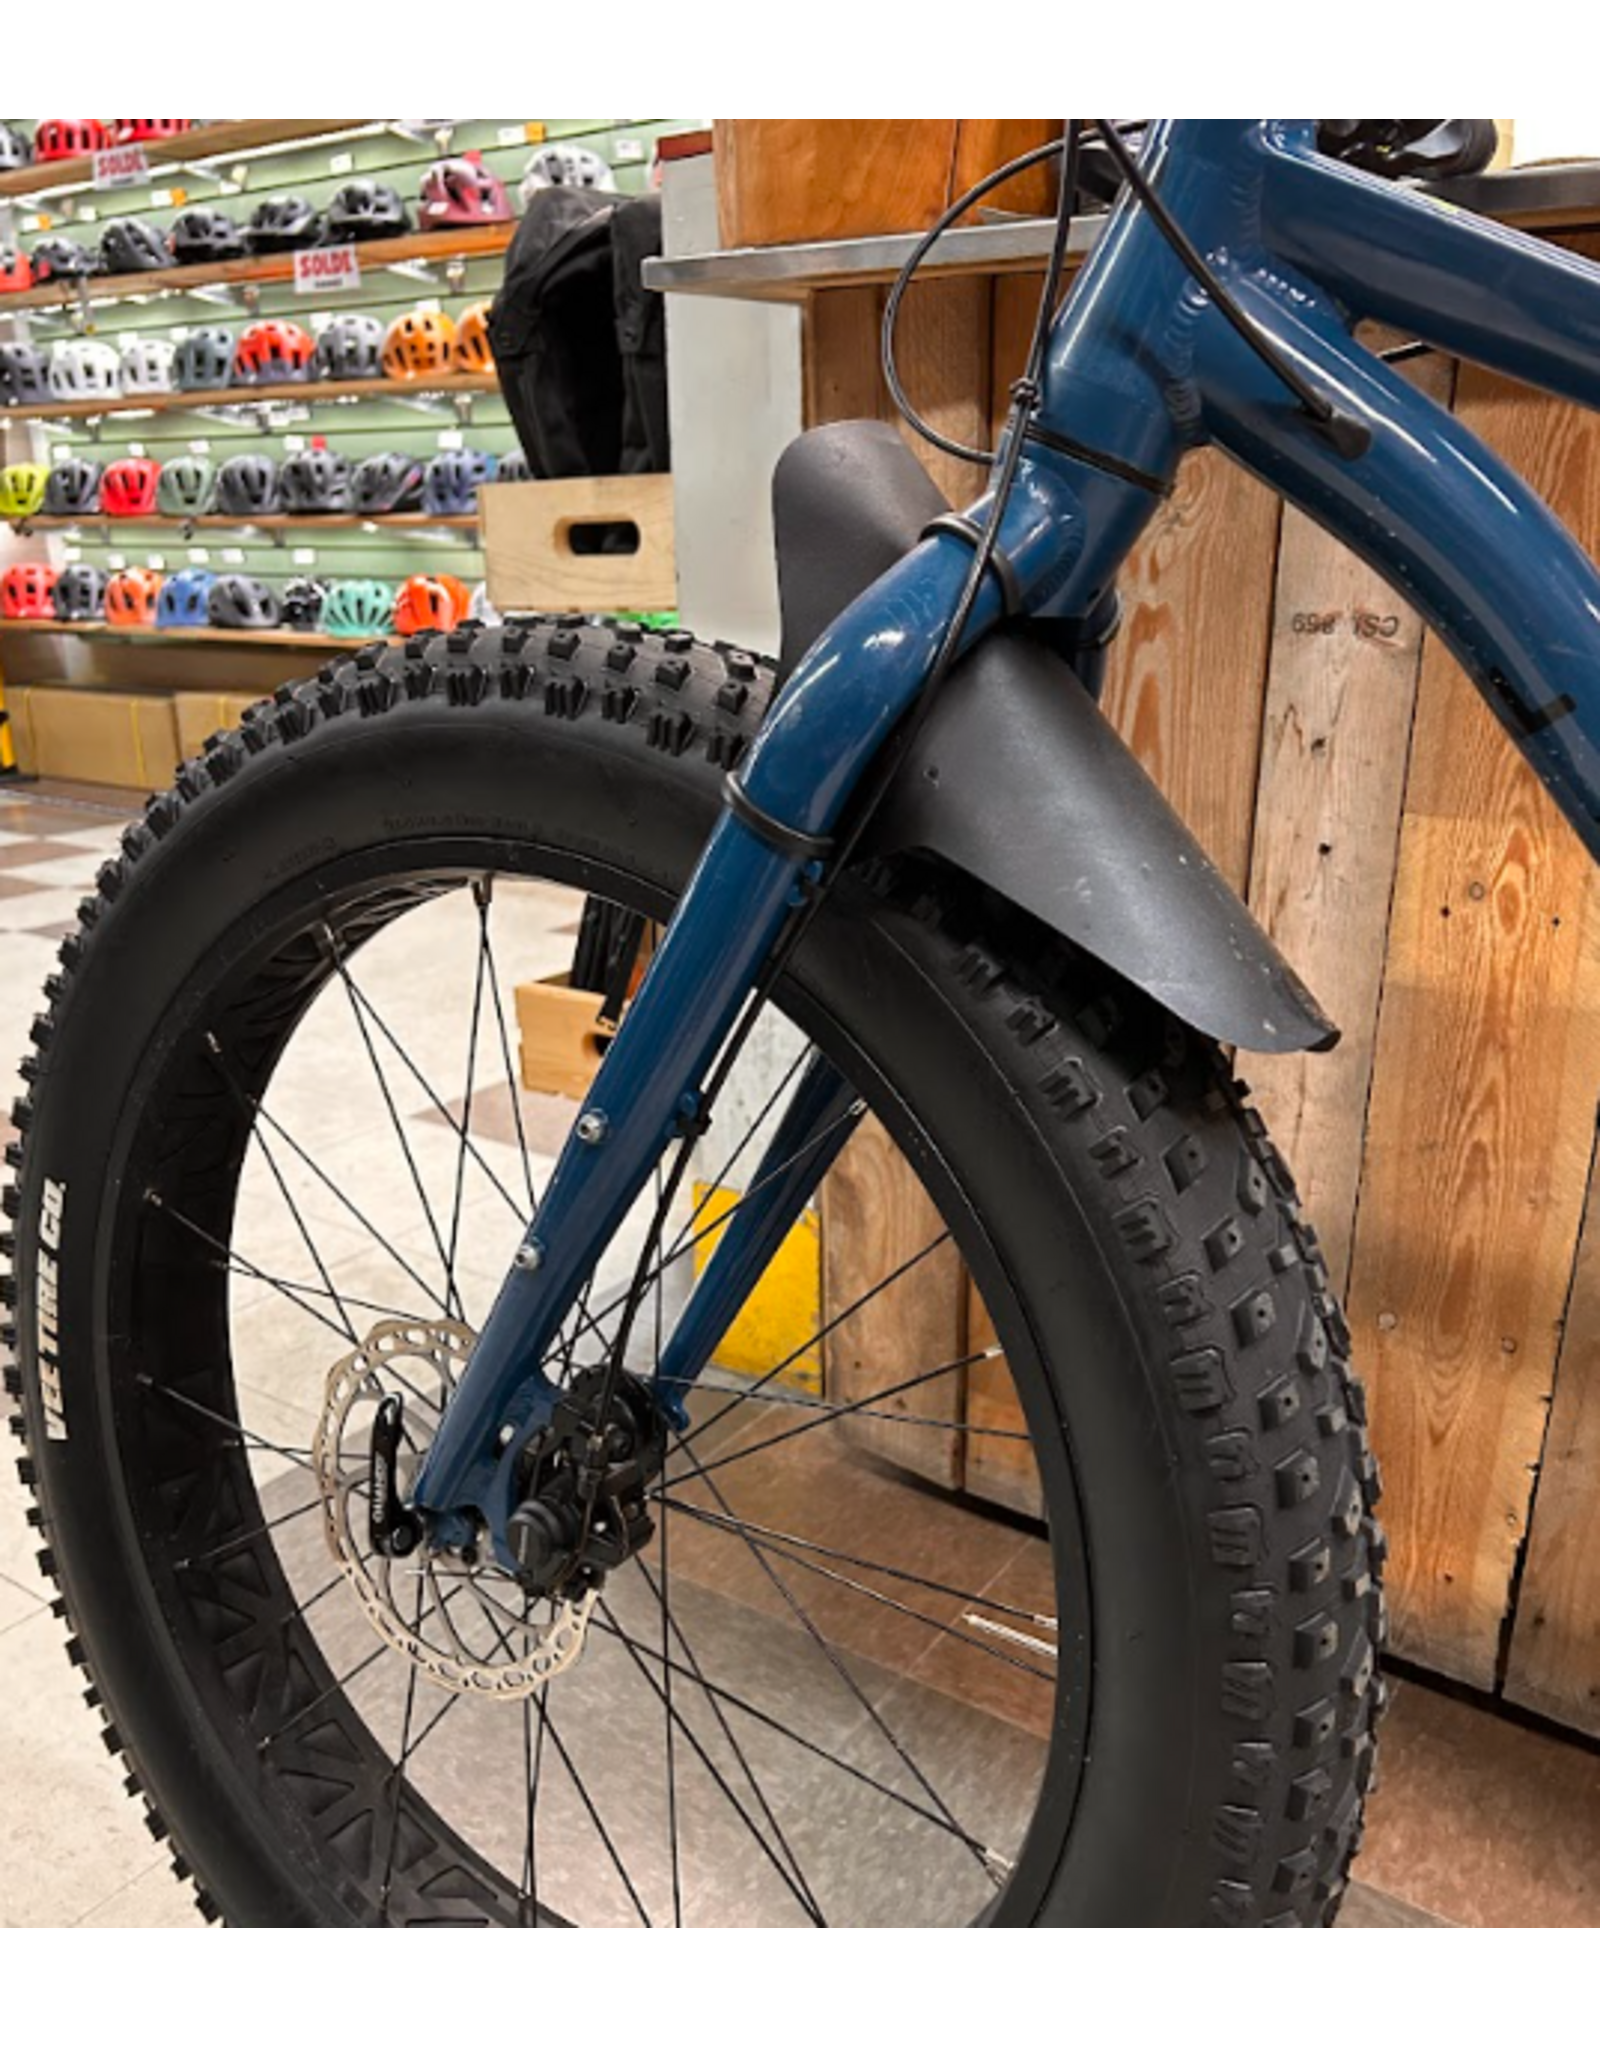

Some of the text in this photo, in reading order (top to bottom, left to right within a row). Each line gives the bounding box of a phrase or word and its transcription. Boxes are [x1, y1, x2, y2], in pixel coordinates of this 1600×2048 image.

[98, 151, 144, 177] SOLDE
[300, 250, 353, 278] SOLDE
[37, 1177, 68, 1440] VEE TIRE CO.
